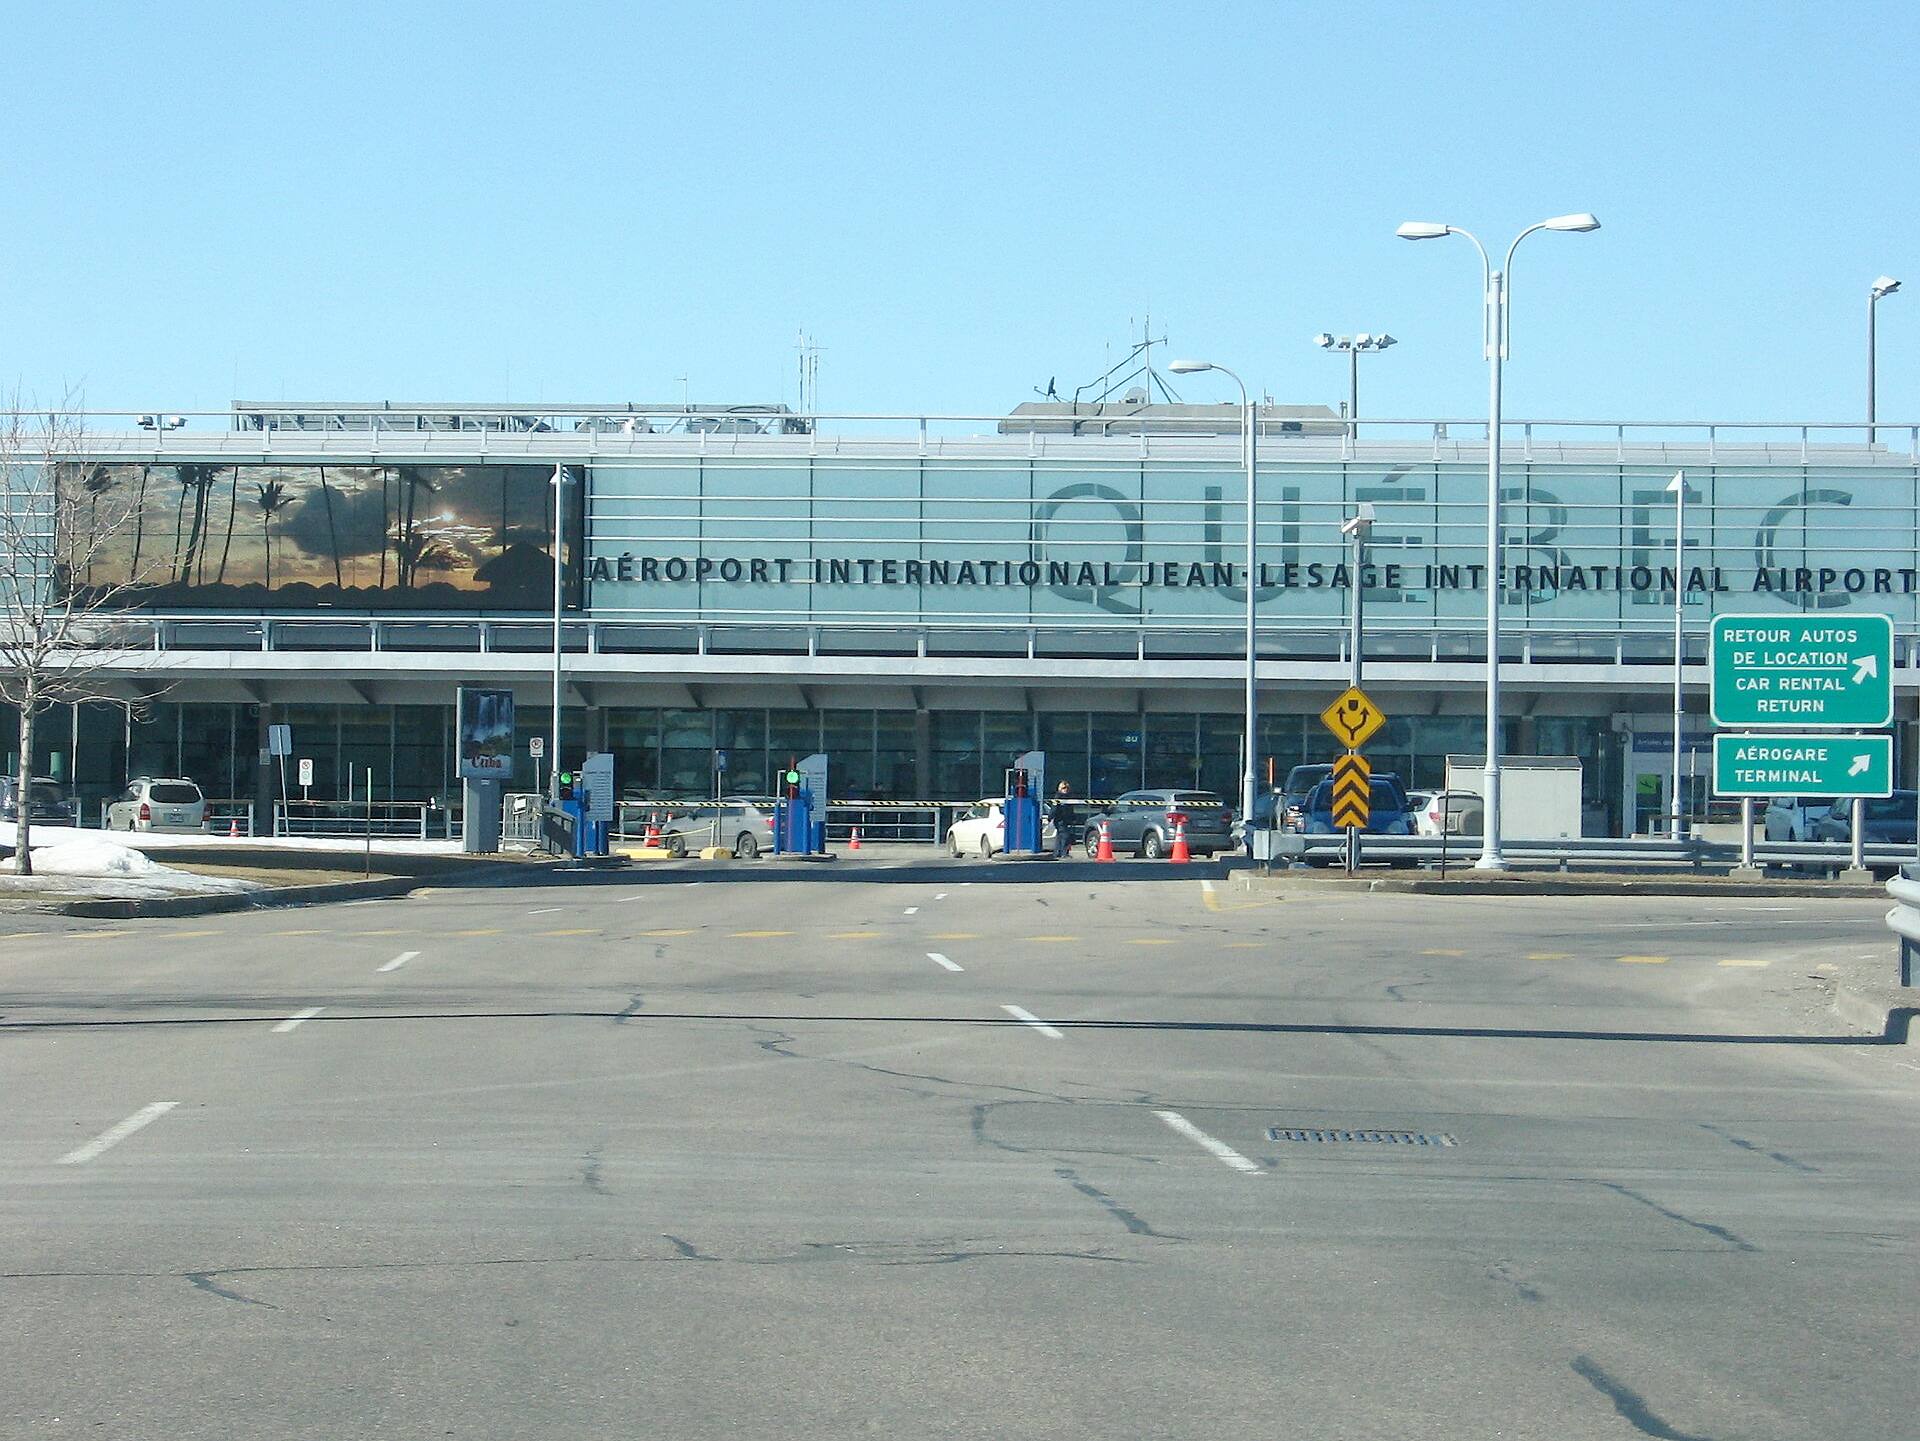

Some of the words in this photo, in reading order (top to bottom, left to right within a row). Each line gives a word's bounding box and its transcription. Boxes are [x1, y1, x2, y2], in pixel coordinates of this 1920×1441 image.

[1034, 464, 1853, 617] QUÉBEC
[592, 552, 792, 582] AÉROPORT
[815, 558, 1120, 586] INTERNATIONAL
[1142, 561, 1401, 589] JEAN-LESAGE
[1752, 567, 1917, 594] AIRPORT
[1723, 629, 1791, 643] RETOUR
[1800, 629, 1858, 643] AUTOS
[1733, 652, 1755, 665] DE
[1764, 652, 1848, 665] LOCATION
[1735, 678, 1770, 691] CAR
[1779, 678, 1846, 691] RENTAL
[1757, 699, 1825, 712] RETURN
[471, 752, 502, 768] Cuba
[1735, 745, 1828, 761] AÉROGARE
[1735, 769, 1823, 783] TERMINAL
